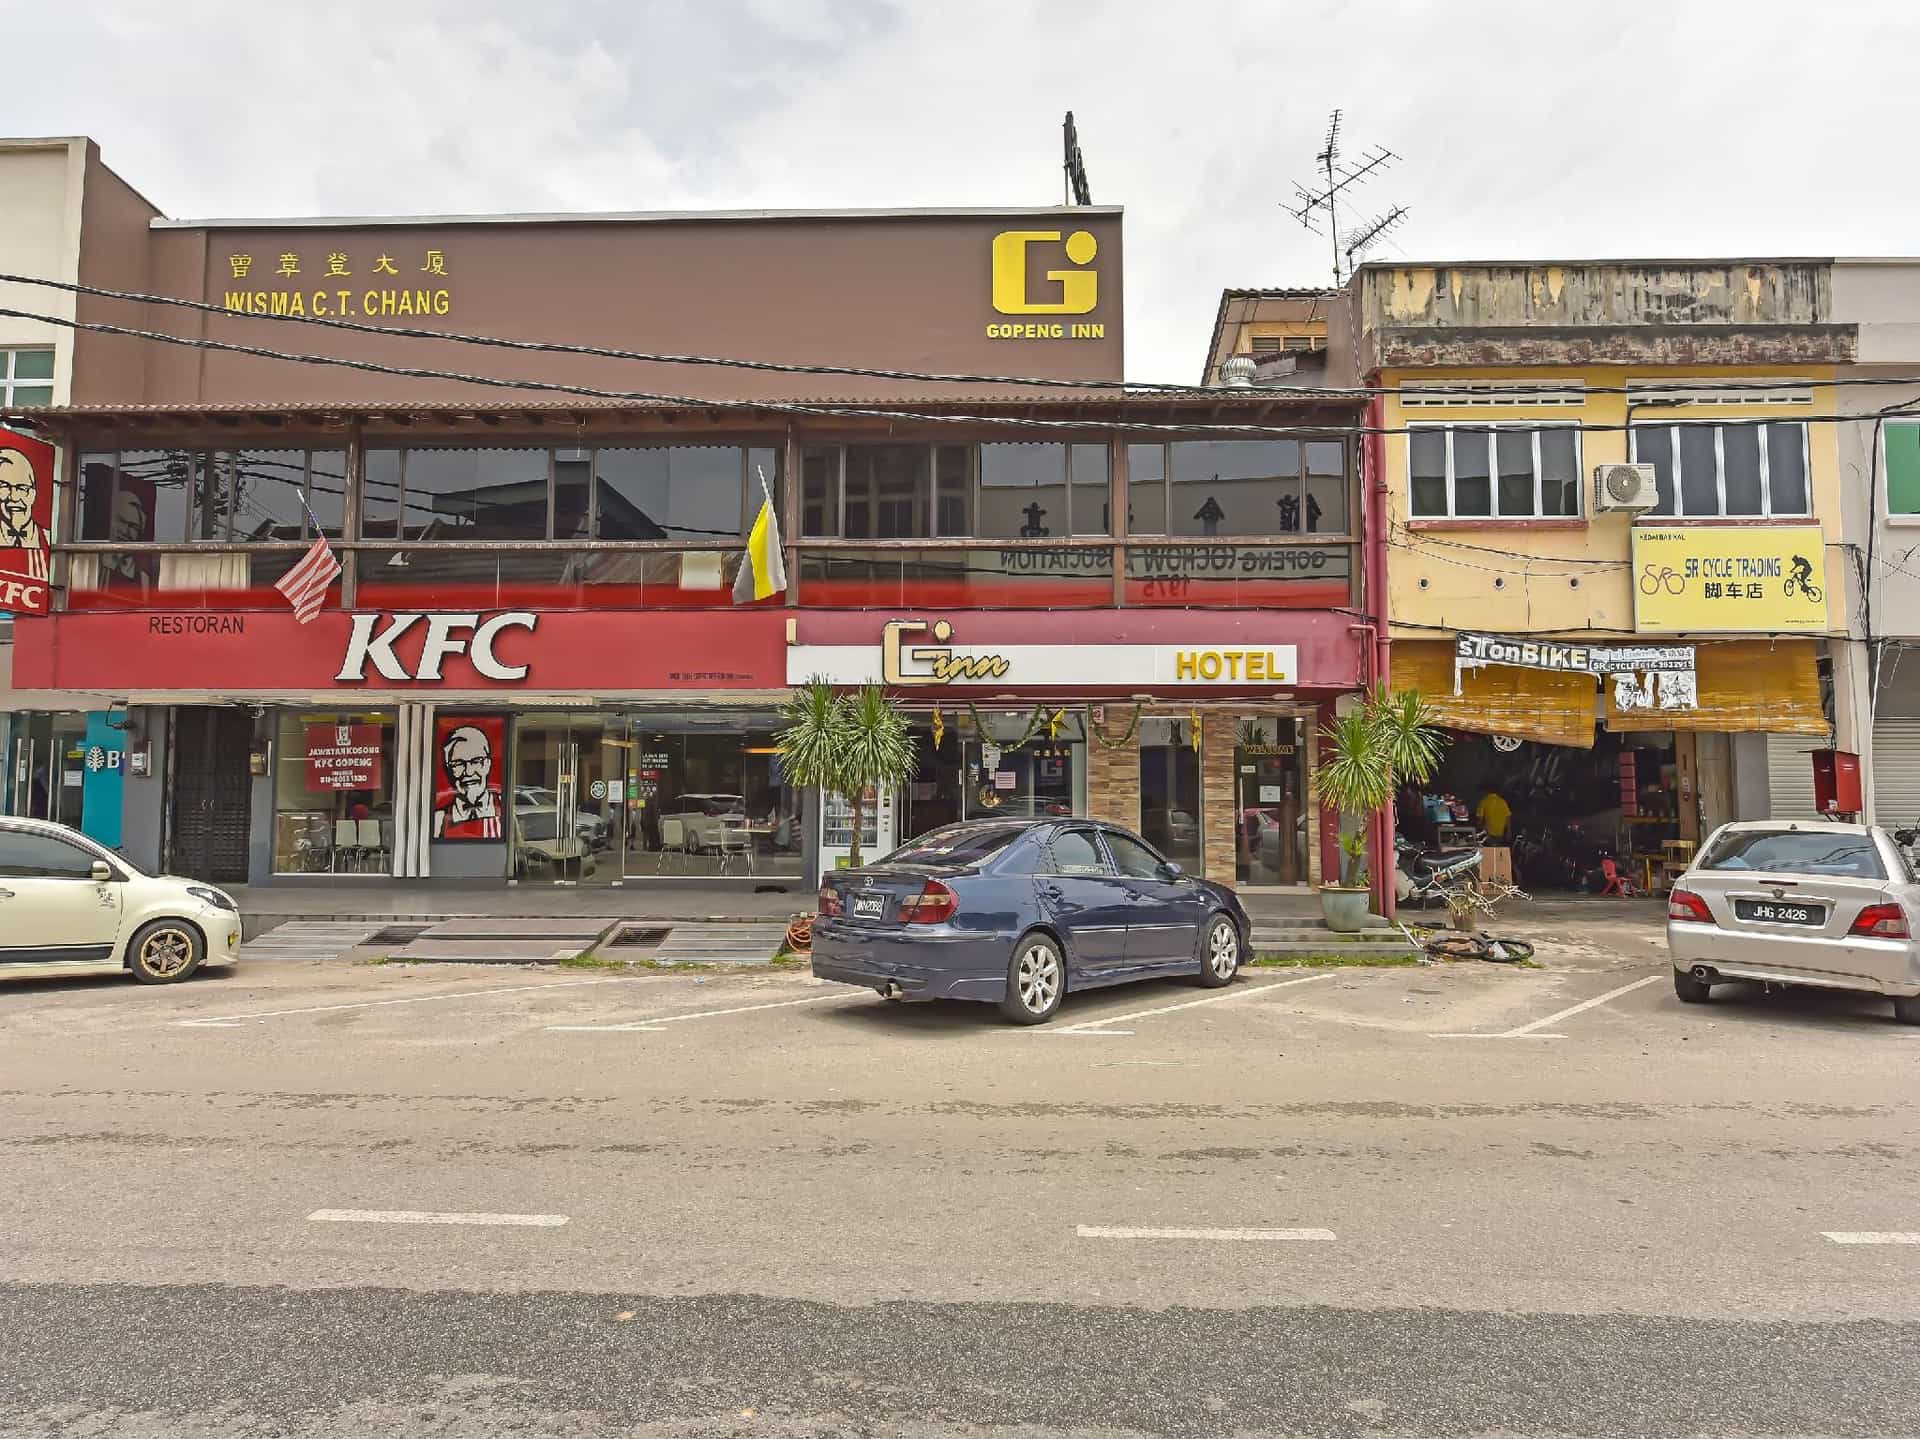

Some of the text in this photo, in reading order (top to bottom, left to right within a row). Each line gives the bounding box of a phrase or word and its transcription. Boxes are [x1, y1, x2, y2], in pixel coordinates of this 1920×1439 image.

[225, 289, 449, 317] WISMA C.T. CHANG
[986, 323, 1105, 339] GOPENG INN
[1685, 558, 1781, 578] SR CYCLE TRADING
[149, 615, 245, 635] RESTORAN
[334, 612, 538, 681] KFC
[1176, 651, 1285, 680] HOTEL
[335, 758, 372, 767] GOPENG
[1753, 905, 1808, 921] JHG 2426
